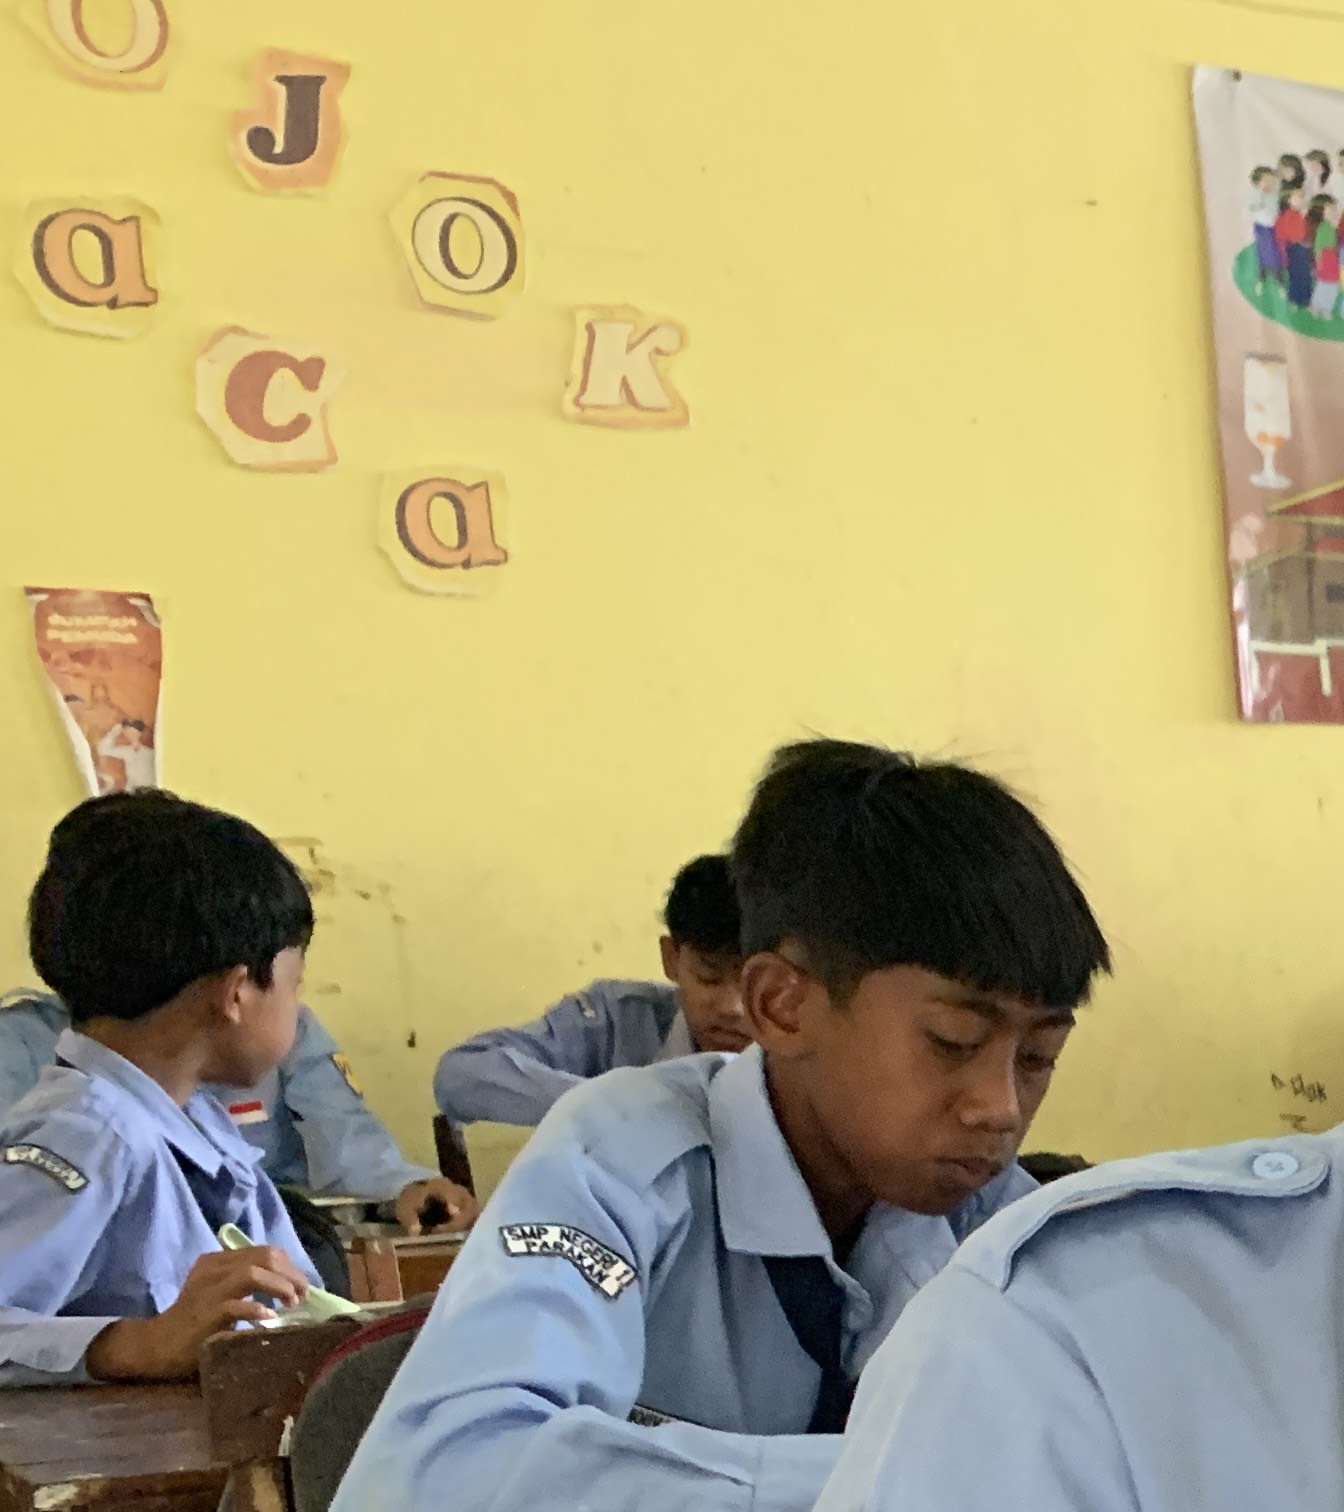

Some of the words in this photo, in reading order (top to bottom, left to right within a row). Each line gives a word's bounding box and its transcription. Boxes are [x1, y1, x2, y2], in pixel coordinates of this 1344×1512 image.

[508, 1226, 549, 1240] SMP
[559, 1227, 620, 1270] NEGERI
[525, 1240, 610, 1284] PARAKAN
